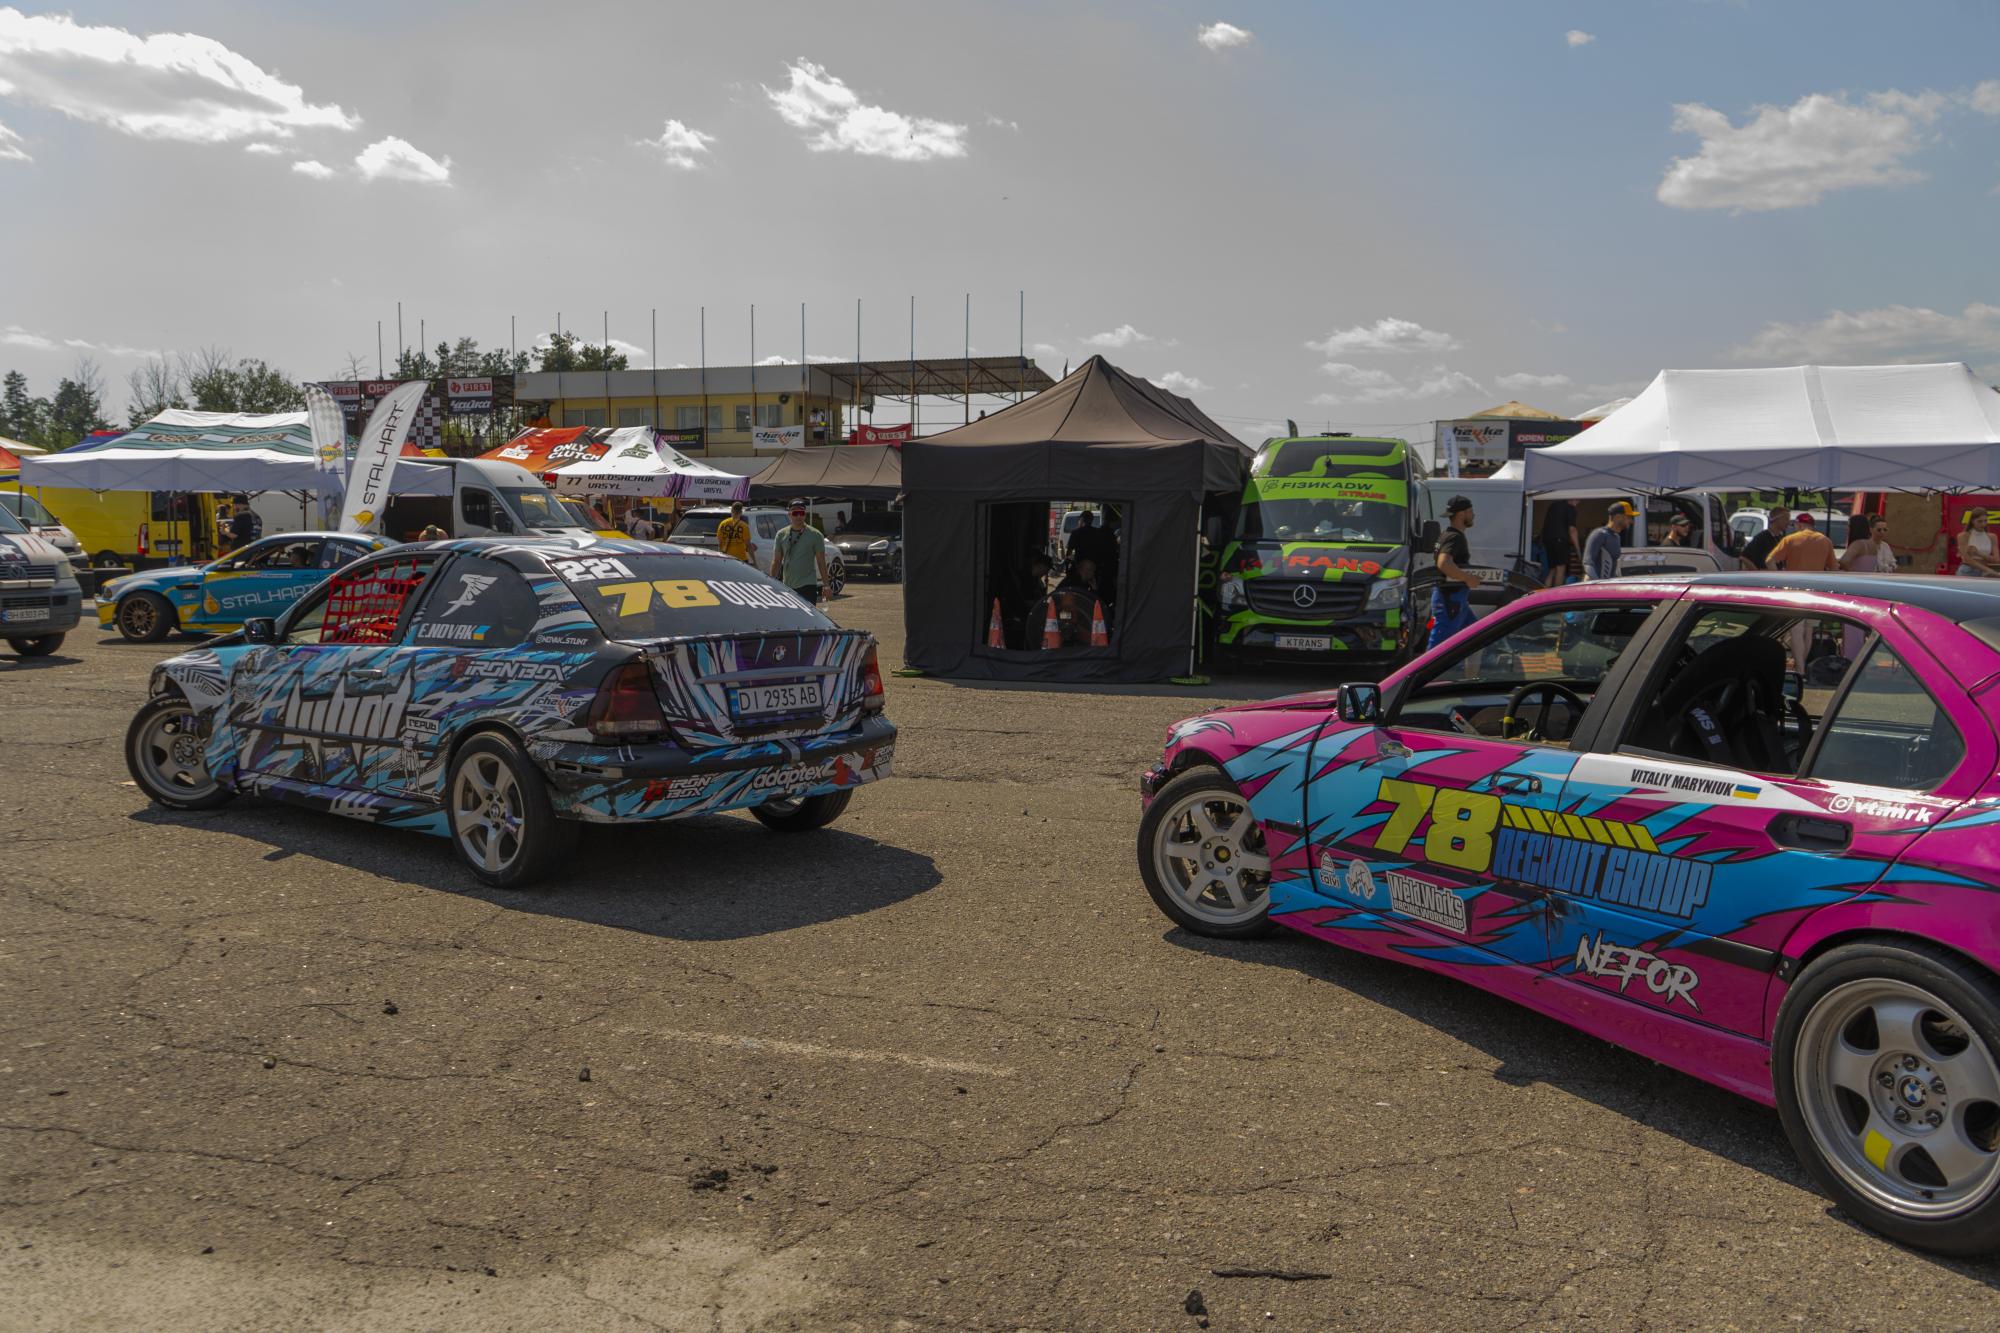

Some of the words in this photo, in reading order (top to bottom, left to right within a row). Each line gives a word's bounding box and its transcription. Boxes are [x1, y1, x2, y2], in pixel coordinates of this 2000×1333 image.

[463, 383, 491, 392] FIRST
[552, 442, 588, 452] ONLY
[1517, 434, 1544, 442] OPEN
[363, 402, 404, 506] STALHART
[548, 449, 601, 461] CLUTCH
[566, 477, 582, 485] 77
[694, 478, 731, 486] VOLOSHCHUK
[552, 557, 637, 582] 221
[597, 580, 720, 617] 78
[418, 623, 476, 640] E.NOVAK
[1286, 638, 1322, 648] KTRANS
[739, 692, 758, 711] DI
[764, 688, 797, 708] 2935
[800, 686, 818, 704] AB
[752, 763, 823, 792] adaptex
[1631, 769, 1673, 788] VITALIY
[1671, 775, 1735, 796] MARYNIUK
[1374, 776, 1503, 873] 78
[1492, 827, 1608, 898] RECRUIT
[1600, 846, 1714, 920] GROUP
[1575, 930, 1702, 1015] NEFOR
